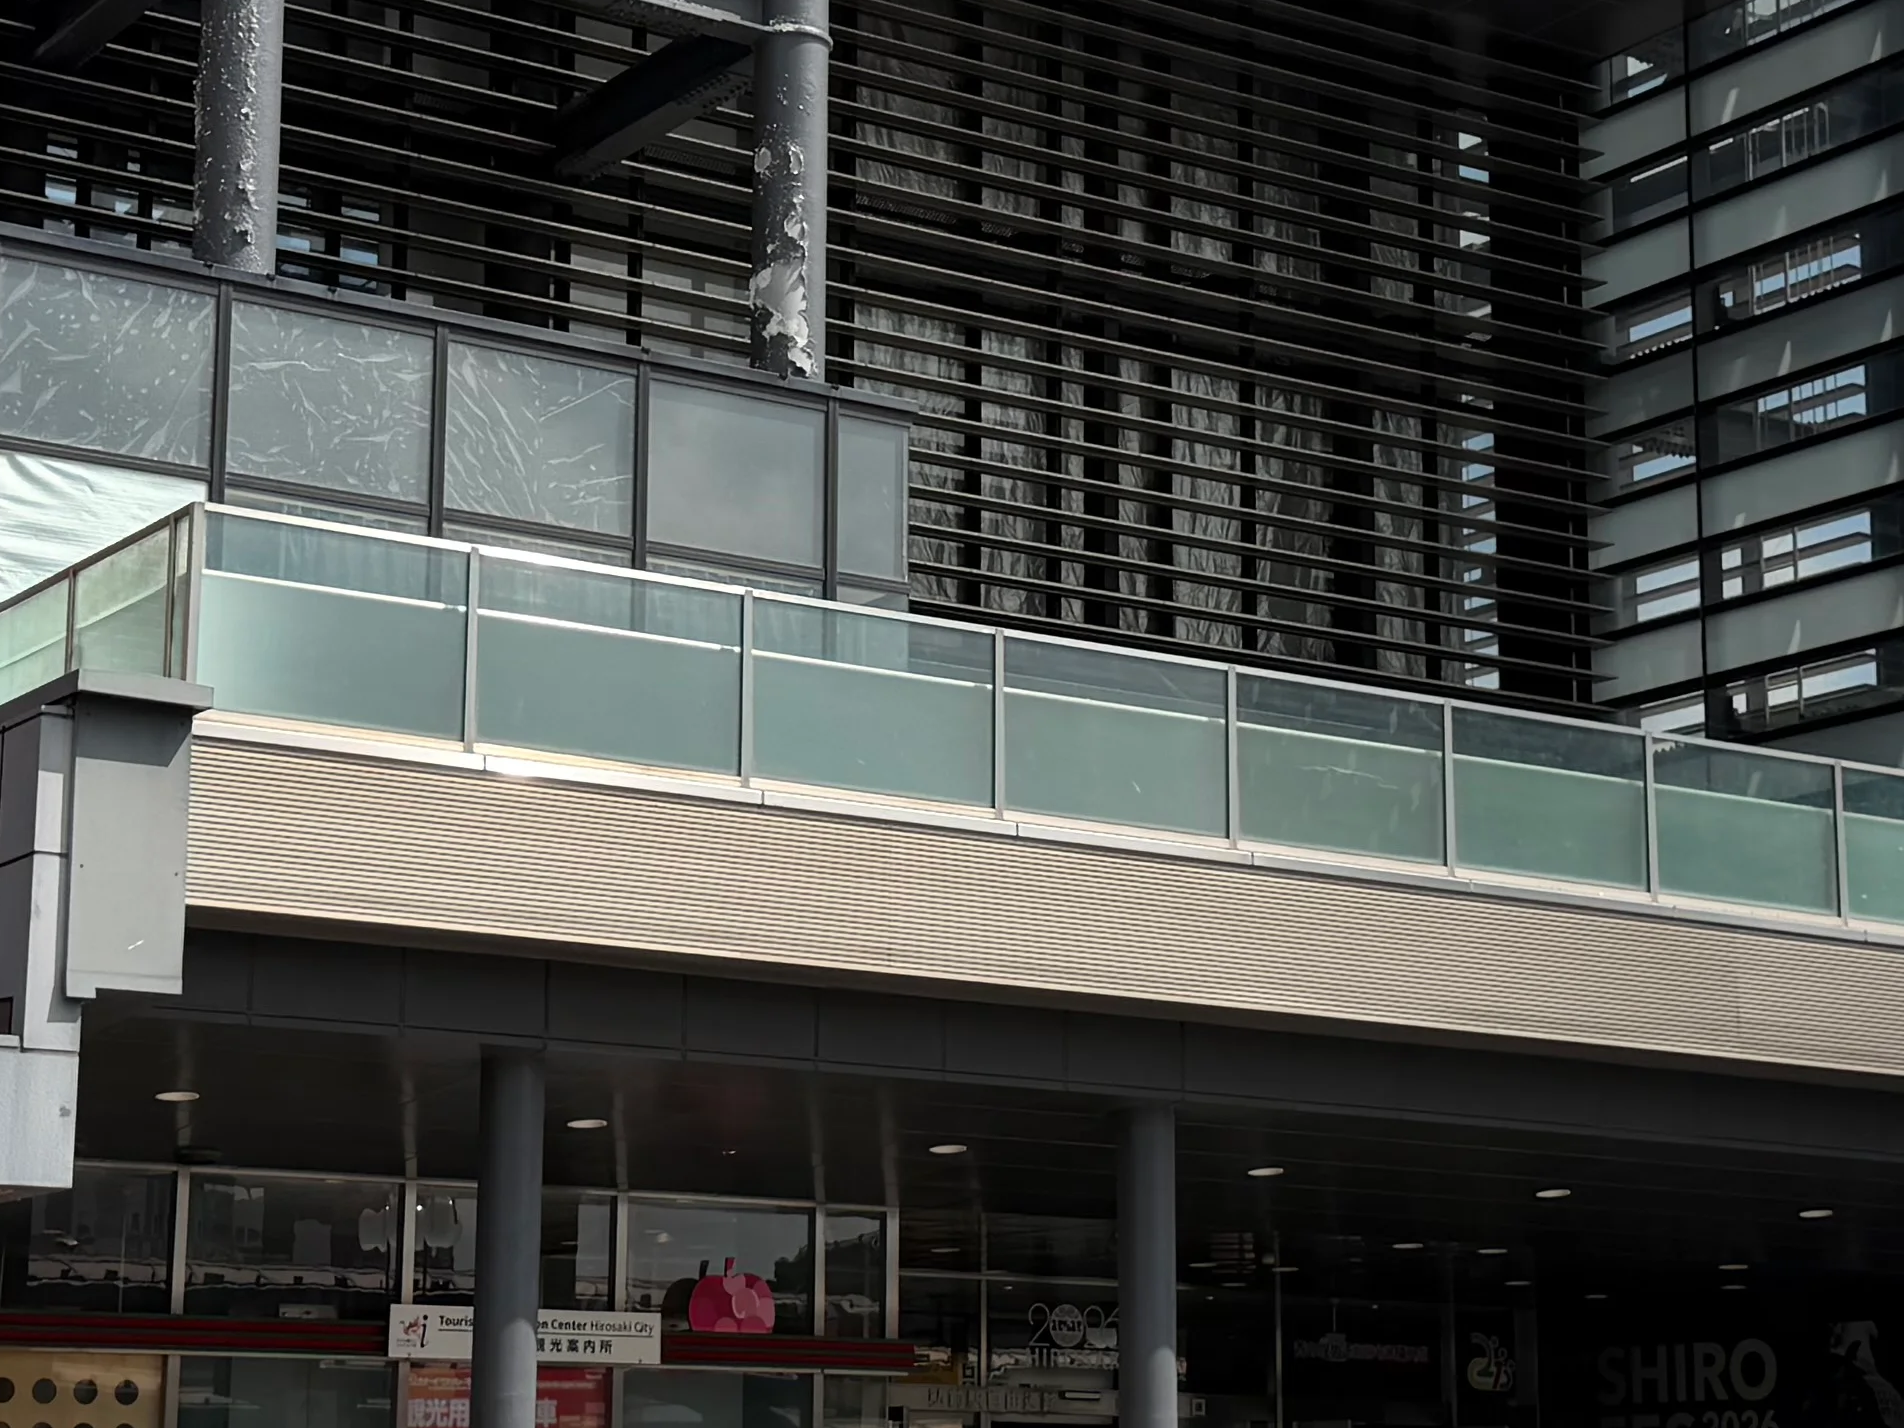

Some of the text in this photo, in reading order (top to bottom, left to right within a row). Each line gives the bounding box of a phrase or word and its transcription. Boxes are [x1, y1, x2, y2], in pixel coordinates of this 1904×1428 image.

[439, 1314, 473, 1327] Touris
[551, 1319, 587, 1331] Center
[590, 1320, 632, 1332] Hirosaki
[634, 1321, 654, 1335] City
[1596, 1338, 1778, 1406] SHIRO
